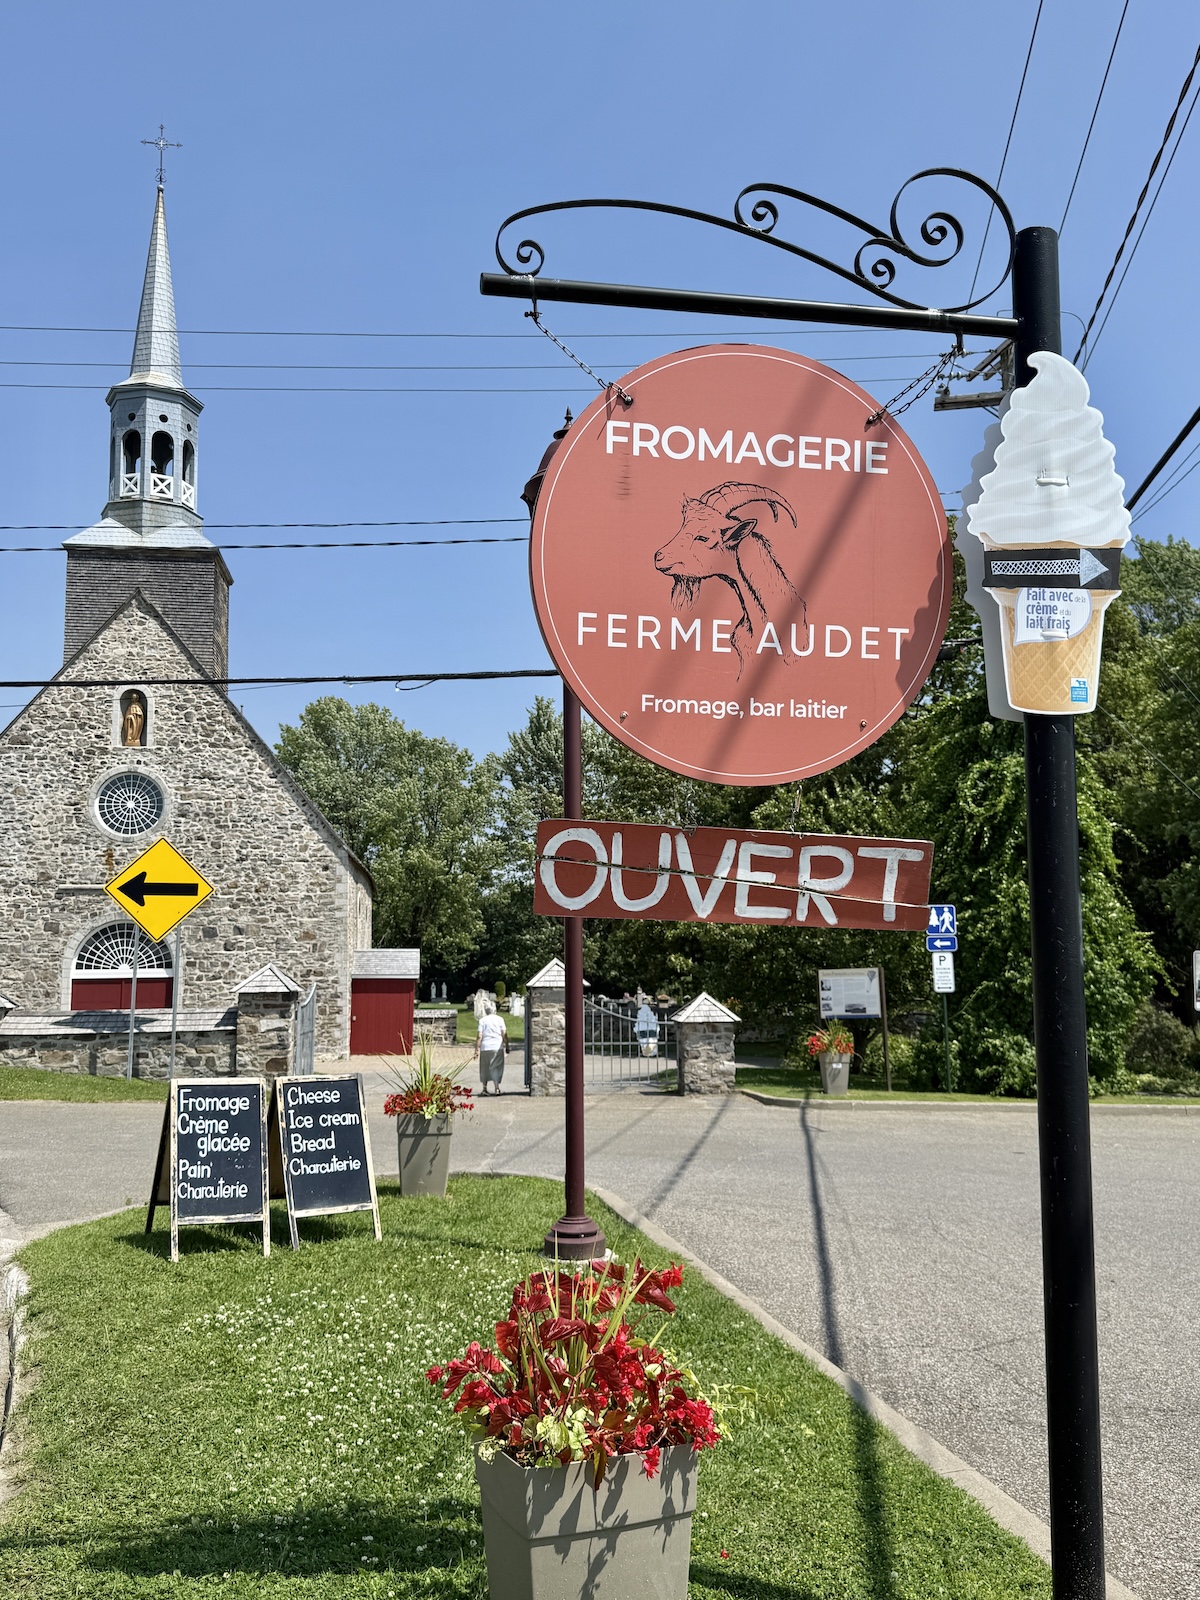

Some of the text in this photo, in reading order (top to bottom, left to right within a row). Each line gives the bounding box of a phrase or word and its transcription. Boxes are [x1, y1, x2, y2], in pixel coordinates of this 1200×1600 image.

[606, 420, 889, 475] FROMAGERIE
[1026, 588, 1046, 601] Fait
[1049, 591, 1073, 602] avec
[1026, 615, 1071, 630] lait frais
[577, 612, 910, 661] FERME AUDET
[641, 694, 848, 720] Fromage, bar laitier
[539, 828, 924, 925] OUVERT
[938, 955, 947, 966] P
[179, 1089, 250, 1115] Fromage
[287, 1086, 341, 1106] Cheese
[177, 1113, 229, 1135] Crème
[288, 1109, 360, 1129] Ice cream
[197, 1133, 251, 1158] glacée
[290, 1131, 336, 1154] Bread
[178, 1159, 213, 1180] Pain
[289, 1155, 362, 1176] Charcuterie
[177, 1177, 249, 1200] Charcuterie
